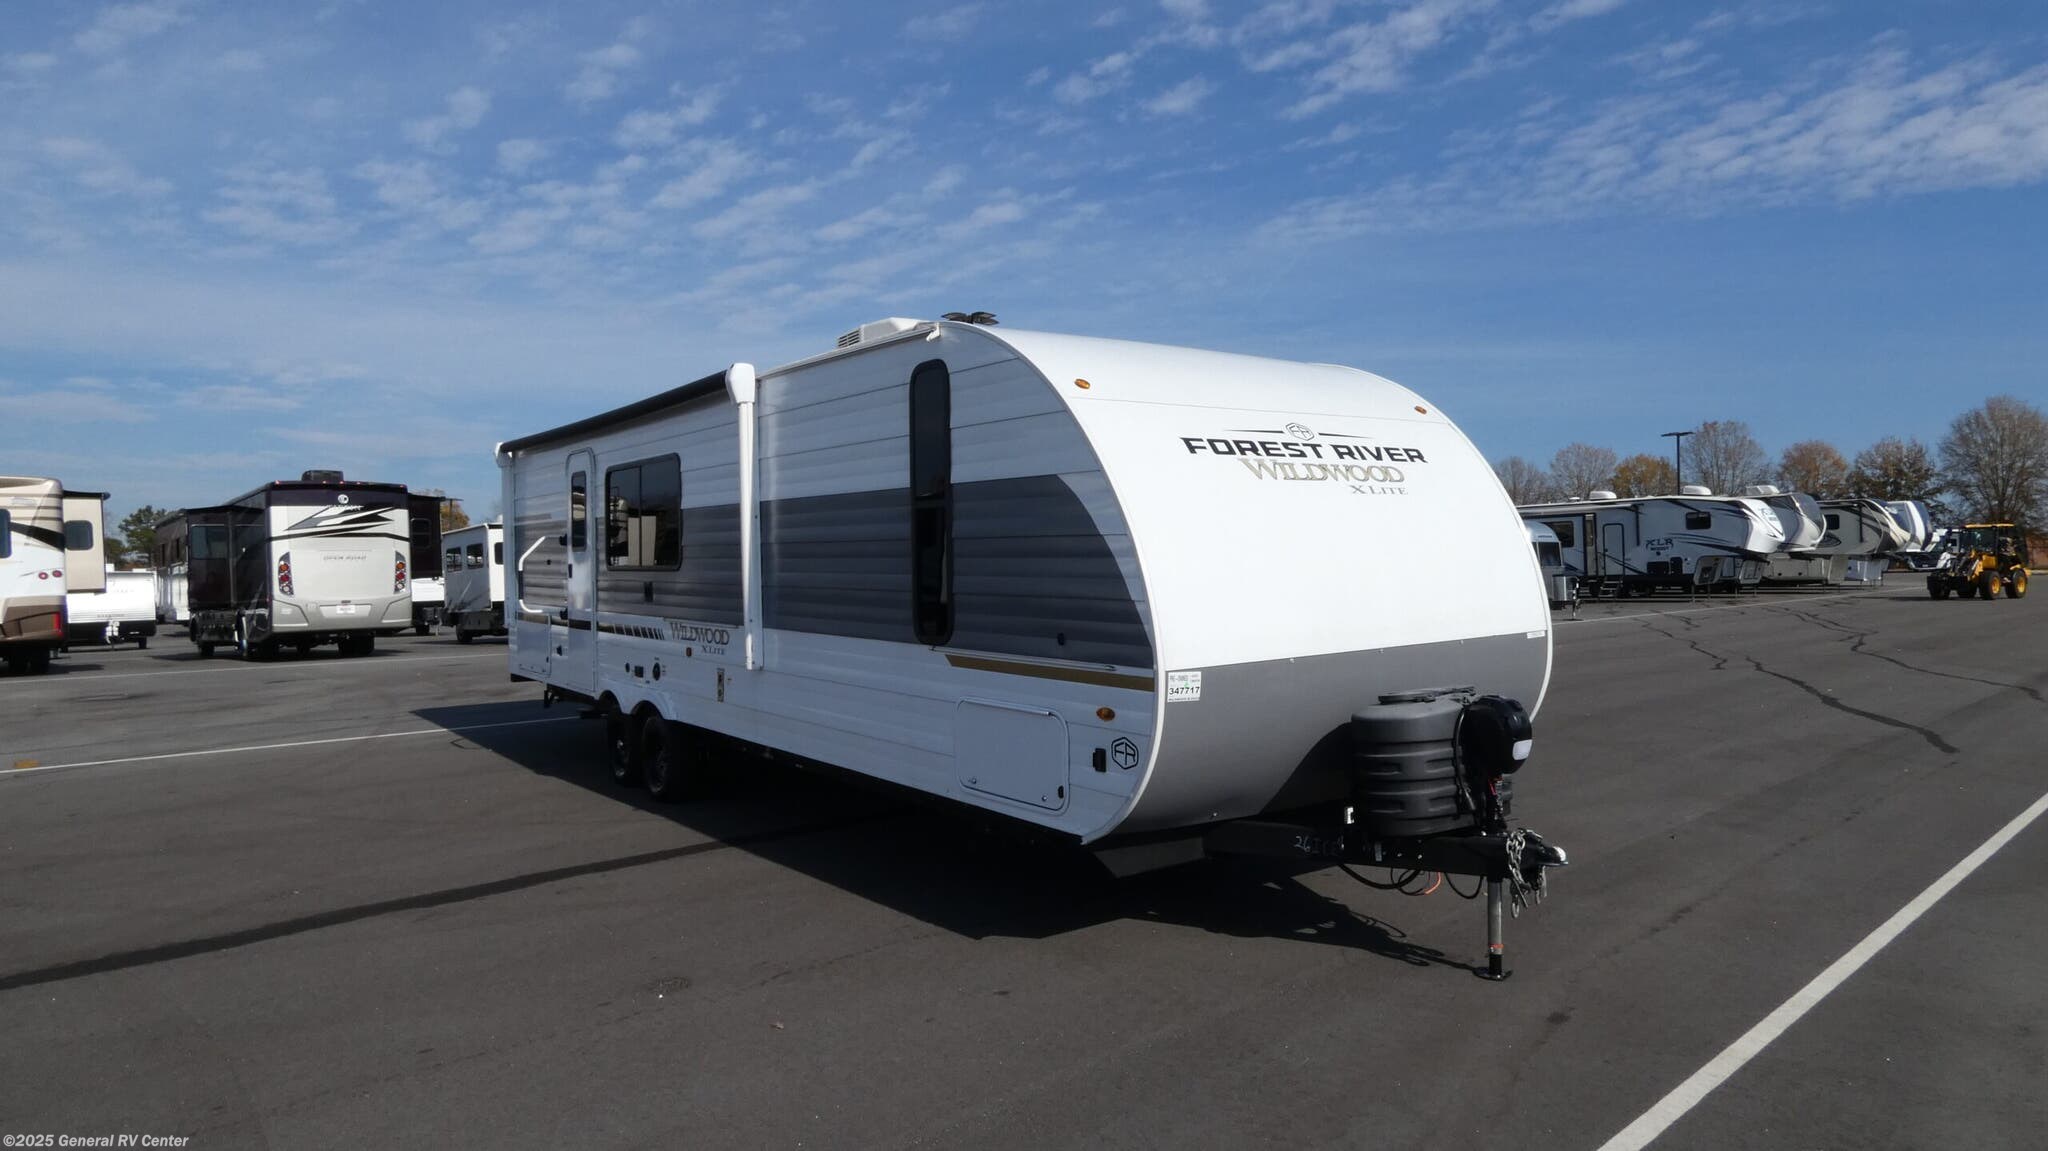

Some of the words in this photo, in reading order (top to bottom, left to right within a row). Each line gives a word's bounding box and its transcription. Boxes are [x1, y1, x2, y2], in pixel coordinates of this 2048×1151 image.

[1179, 437, 1323, 459] FOREST
[1330, 444, 1429, 463] RIVER
[1237, 458, 1405, 483] WILDWOOD
[1350, 484, 1365, 495] X
[1367, 485, 1409, 496] LITE
[670, 622, 730, 645] WILDWOOD
[1168, 686, 1200, 696] 347717
